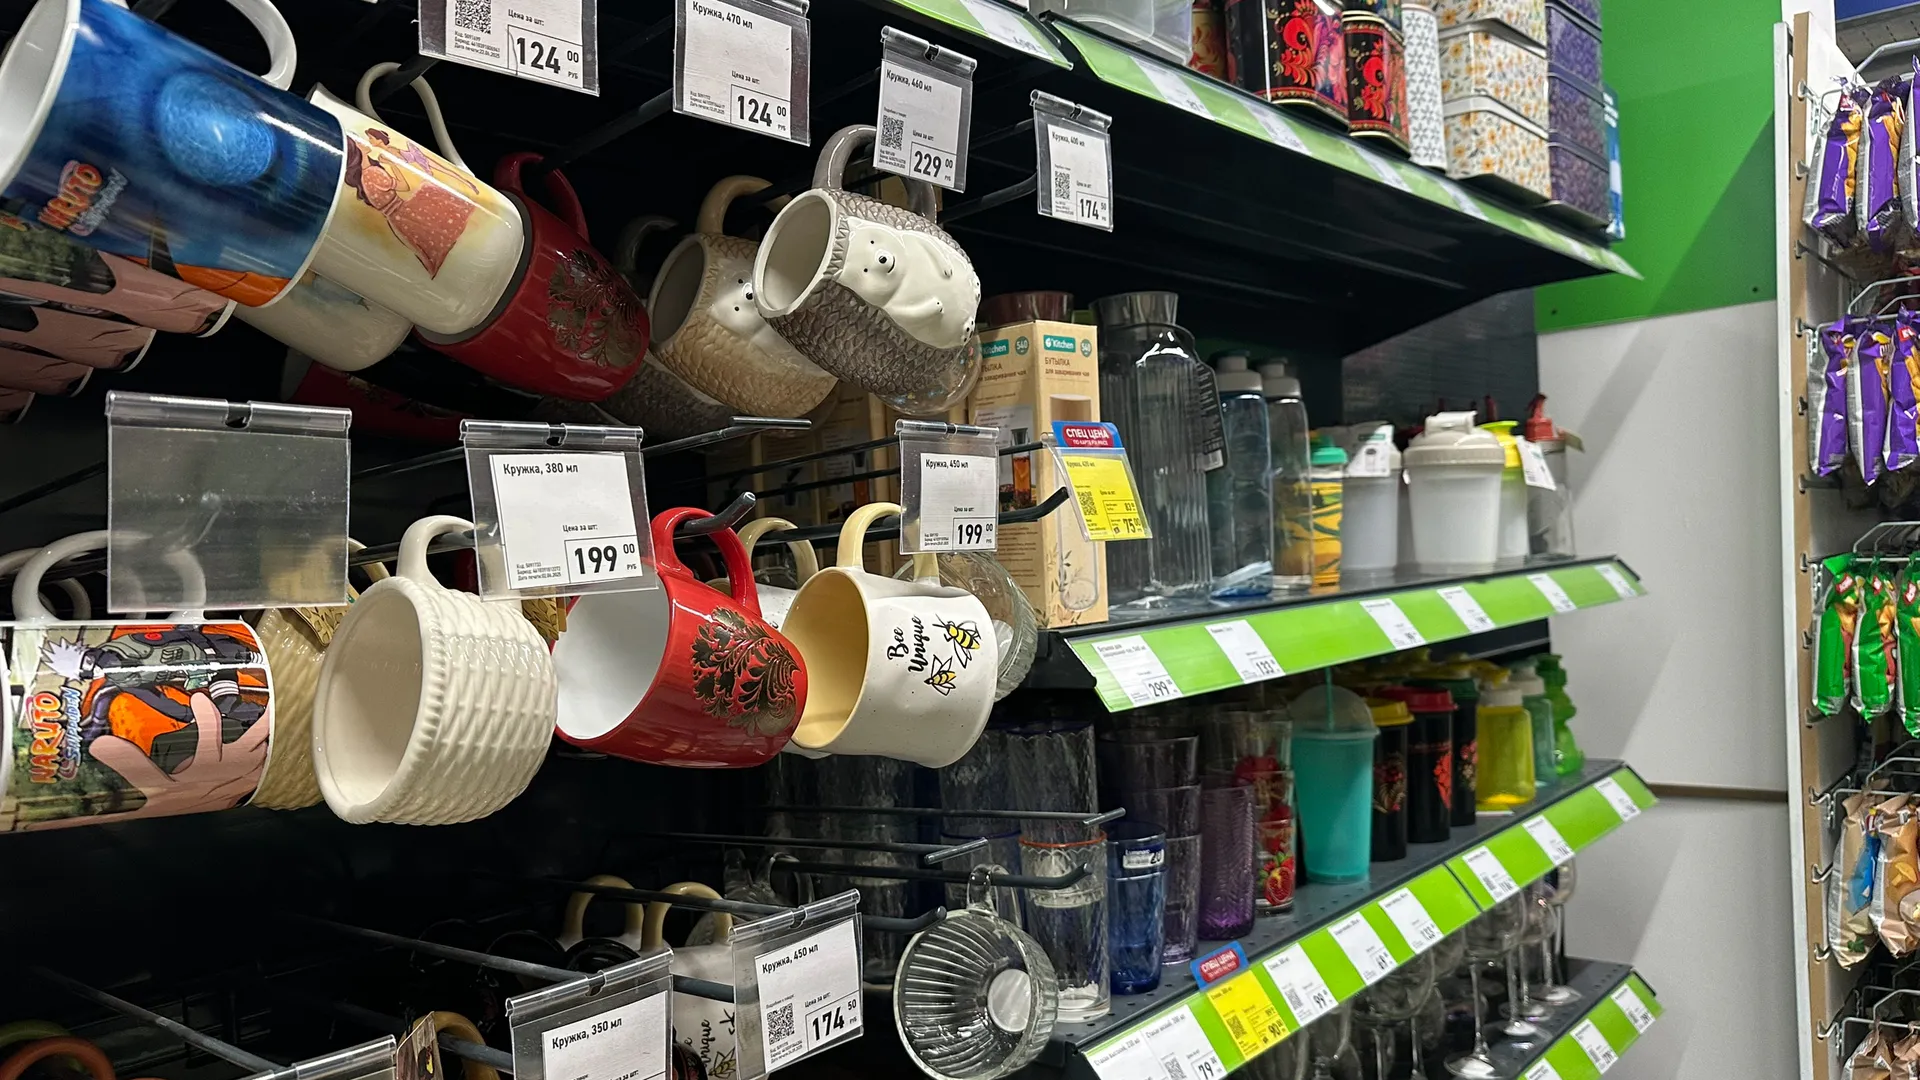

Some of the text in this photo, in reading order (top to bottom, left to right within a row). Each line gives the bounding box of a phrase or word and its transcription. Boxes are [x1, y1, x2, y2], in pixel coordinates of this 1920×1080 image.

[508, 9, 545, 26] Цена за шт:
[692, 1, 753, 29] Кружка, 470 мл
[517, 37, 561, 74] 124
[567, 50, 579, 63] 00
[568, 71, 579, 79] РУБ
[732, 70, 745, 80] Цена
[886, 69, 932, 93] Кружка, 460 мл
[737, 95, 772, 127] 124
[777, 105, 787, 117] 00
[1052, 131, 1071, 144] Кружка,
[913, 150, 942, 178] 229
[945, 158, 954, 169] 00
[1079, 198, 1099, 220] 174
[1016, 340, 1028, 350] 540
[1045, 357, 1071, 366] БУТЫЛКА
[1066, 428, 1110, 439] СПЕЦ ЦЕНА
[503, 463, 578, 477] Кружка, 380 мл
[925, 459, 949, 469] Кружка,
[949, 459, 959, 468] 450
[562, 524, 578, 533] Цена
[958, 524, 983, 545] 199
[986, 523, 993, 532] 00
[1123, 518, 1136, 533] 75
[574, 544, 635, 575] 199 00
[887, 627, 909, 660] Bee
[908, 615, 930, 672] Unique
[1148, 681, 1170, 697] 299
[29, 692, 65, 783] NARUTO
[762, 943, 819, 974] Кружка, 450 мл
[804, 997, 817, 1008] Цена
[812, 999, 857, 1041] 174 50
[552, 1017, 622, 1049] Кружка, 350 мл
[1268, 1023, 1281, 1038] 90
[700, 1019, 716, 1068] nique
[1198, 1061, 1214, 1080] 79
